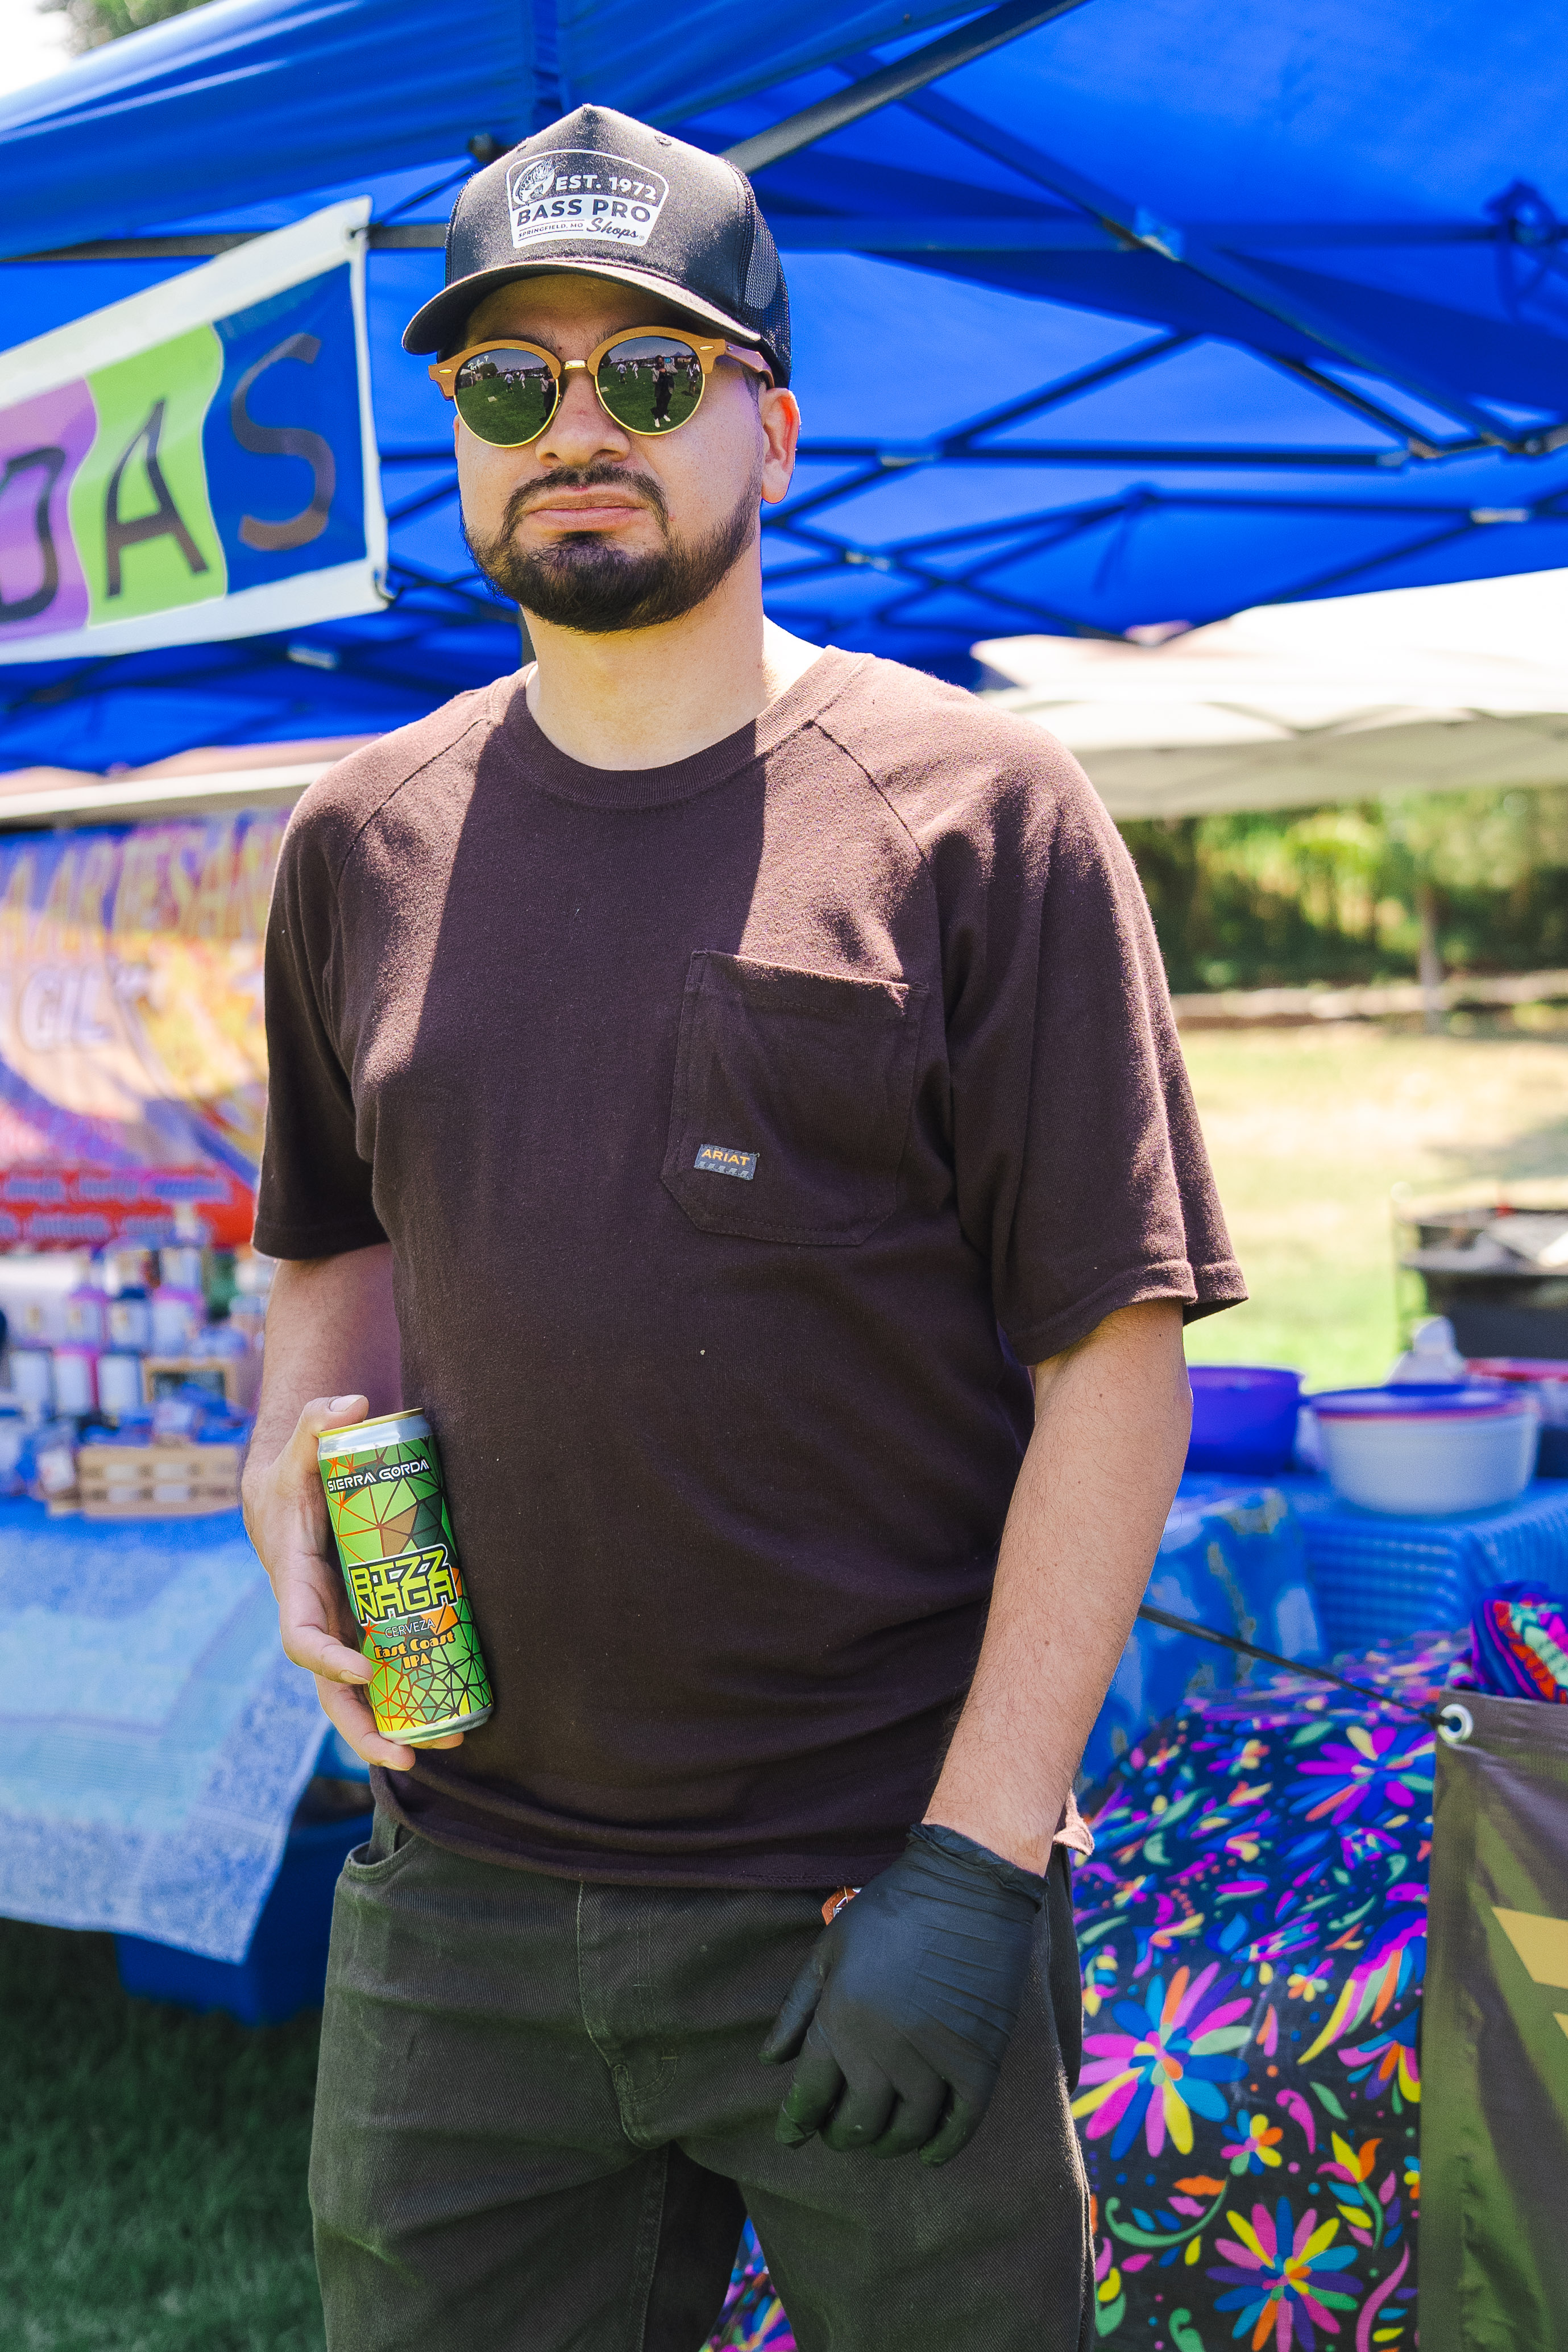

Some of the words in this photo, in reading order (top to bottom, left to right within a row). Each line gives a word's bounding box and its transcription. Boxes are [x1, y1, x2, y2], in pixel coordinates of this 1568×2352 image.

[555, 175, 601, 191] EST.
[609, 176, 656, 200] 1972
[517, 199, 582, 226] BASS
[592, 199, 650, 222] PRO
[586, 217, 638, 239] Shops
[701, 1148, 750, 1165] ARIAT
[328, 1472, 376, 1491] SIERRA
[379, 1459, 429, 1480] GORDA
[350, 1549, 449, 1596] BIZZ
[357, 1570, 454, 1620] NAGA
[384, 1618, 435, 1638] CERVEZA
[374, 1641, 407, 1660] East
[409, 1631, 455, 1652] Coast
[403, 1652, 430, 1669] IPA
